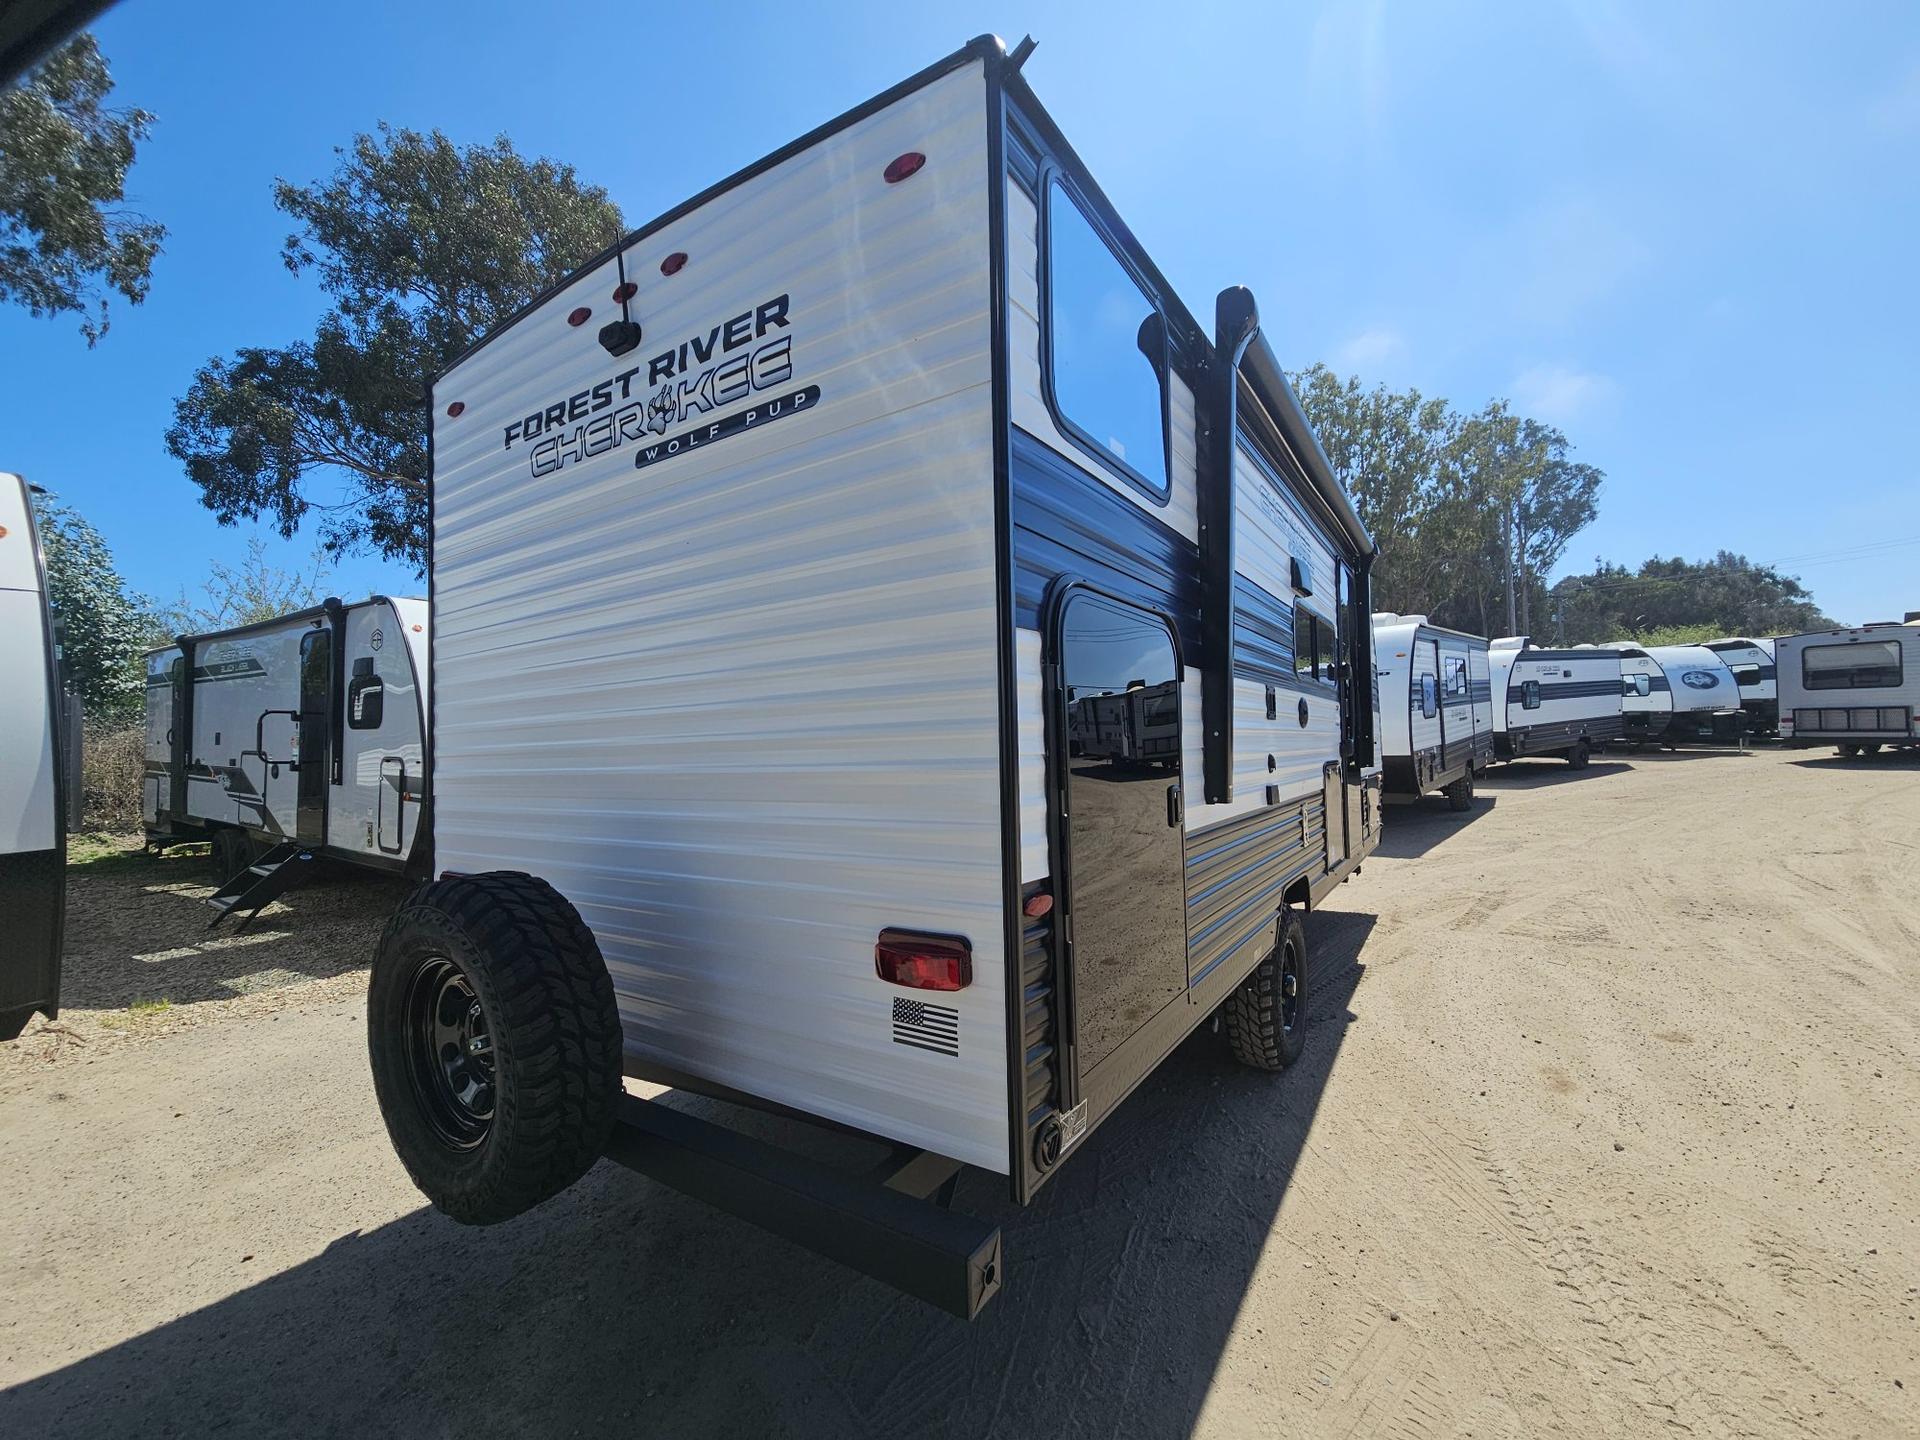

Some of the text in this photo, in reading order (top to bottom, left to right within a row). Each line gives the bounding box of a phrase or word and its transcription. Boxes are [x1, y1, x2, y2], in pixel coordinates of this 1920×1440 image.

[504, 293, 791, 450] FOREST RIVER
[645, 392, 806, 461] WOLF PUP
